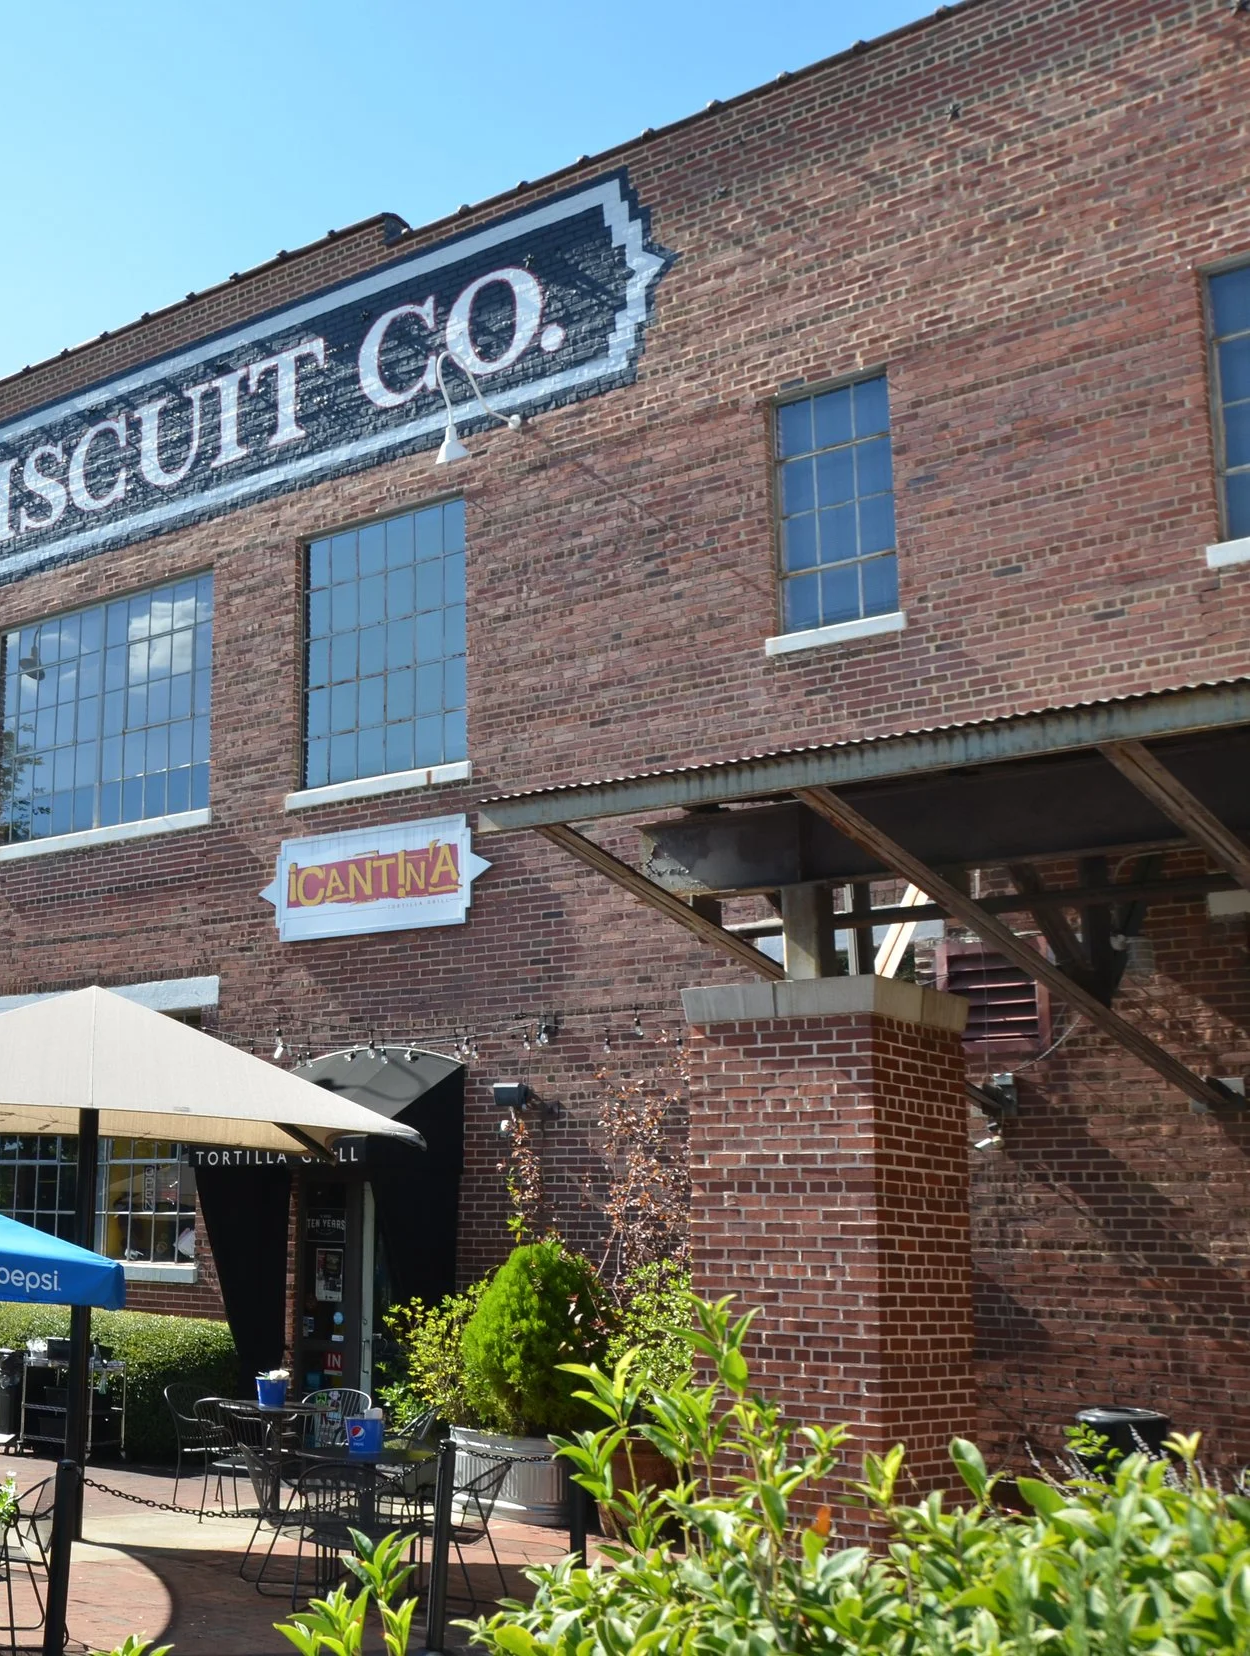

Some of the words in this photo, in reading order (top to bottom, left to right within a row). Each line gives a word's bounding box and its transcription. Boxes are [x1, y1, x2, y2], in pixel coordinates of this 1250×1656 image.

[358, 266, 566, 407] CO.
[195, 1151, 288, 1165] TORTILLA
[307, 1218, 320, 1229] TEN
[322, 1219, 346, 1231] YEARS
